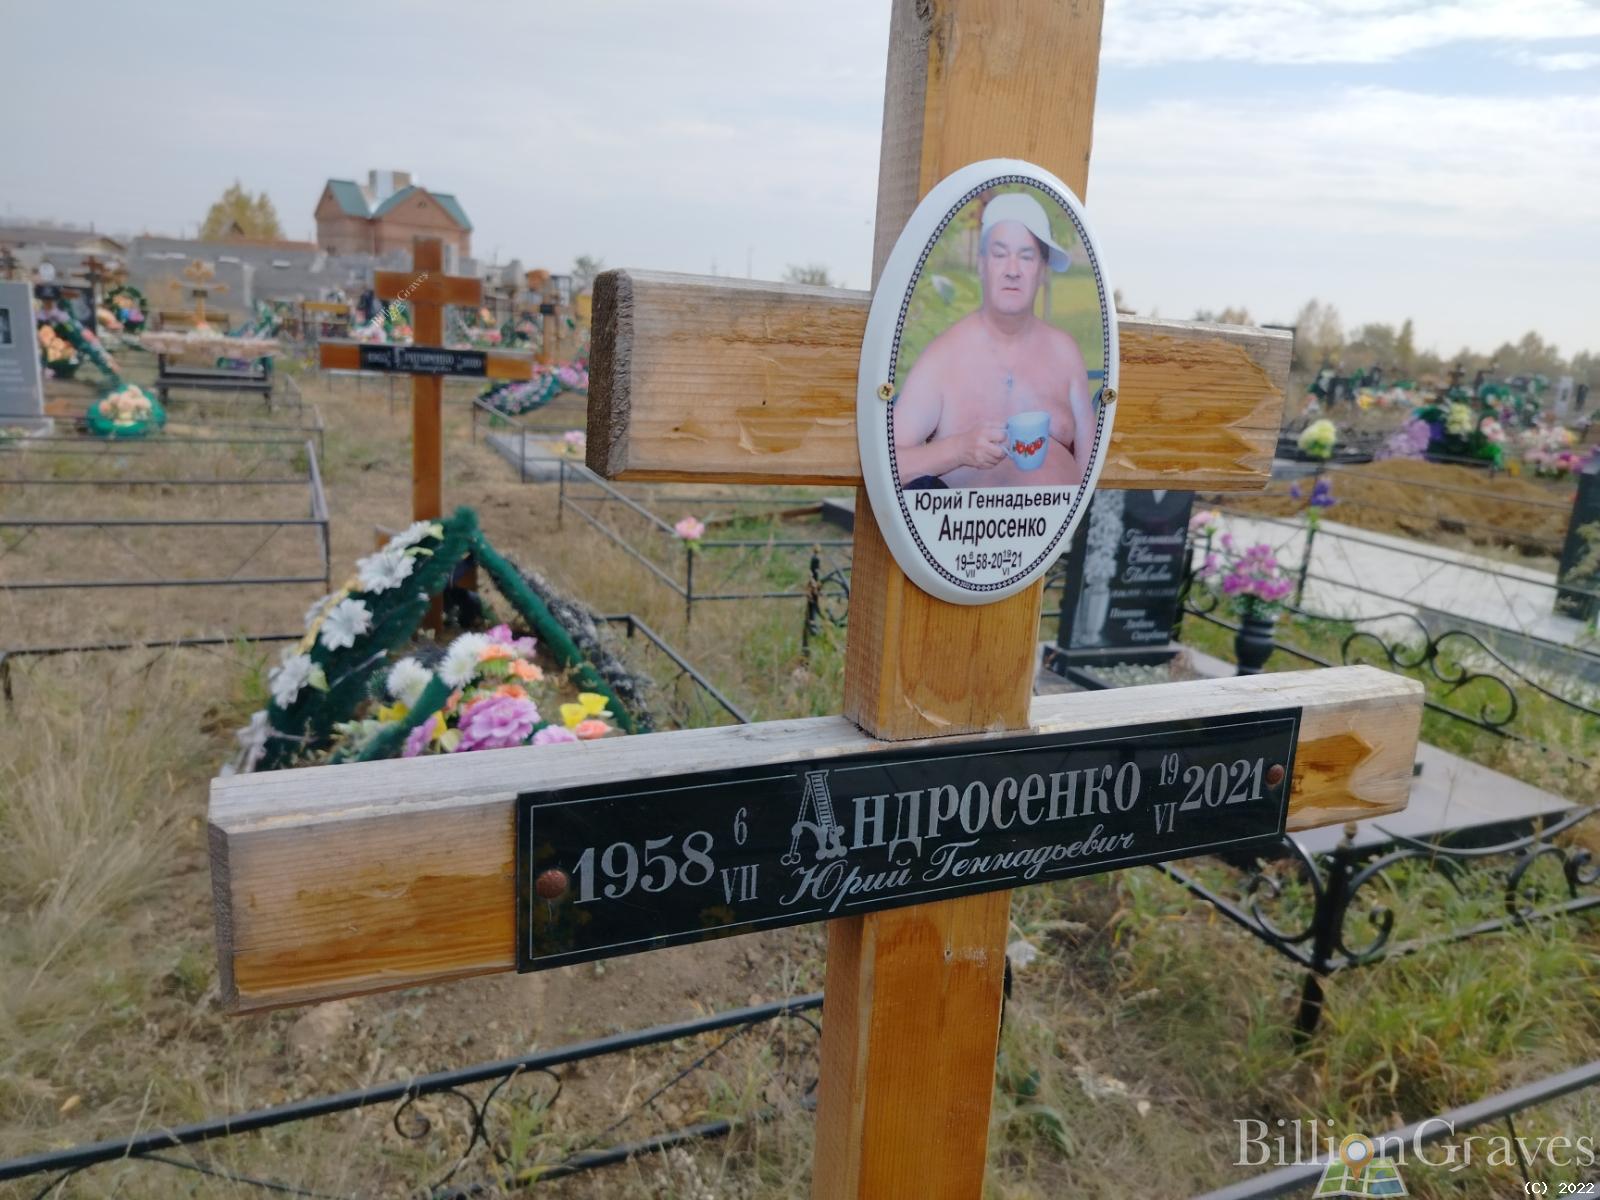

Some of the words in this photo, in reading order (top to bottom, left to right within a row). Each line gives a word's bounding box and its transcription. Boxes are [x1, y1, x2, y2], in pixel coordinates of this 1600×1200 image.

[915, 491, 963, 514] Юрий
[968, 490, 1071, 513] Геннадьевич
[938, 514, 1047, 546] Андросенко
[1159, 752, 1180, 787] 19
[1178, 757, 1265, 812] 2021
[733, 806, 748, 846] 6
[1154, 803, 1179, 835] VI
[572, 830, 716, 904] 1958
[719, 863, 760, 905] VII
[779, 858, 912, 913] Юрий
[922, 823, 1135, 880] Геннадьевич
